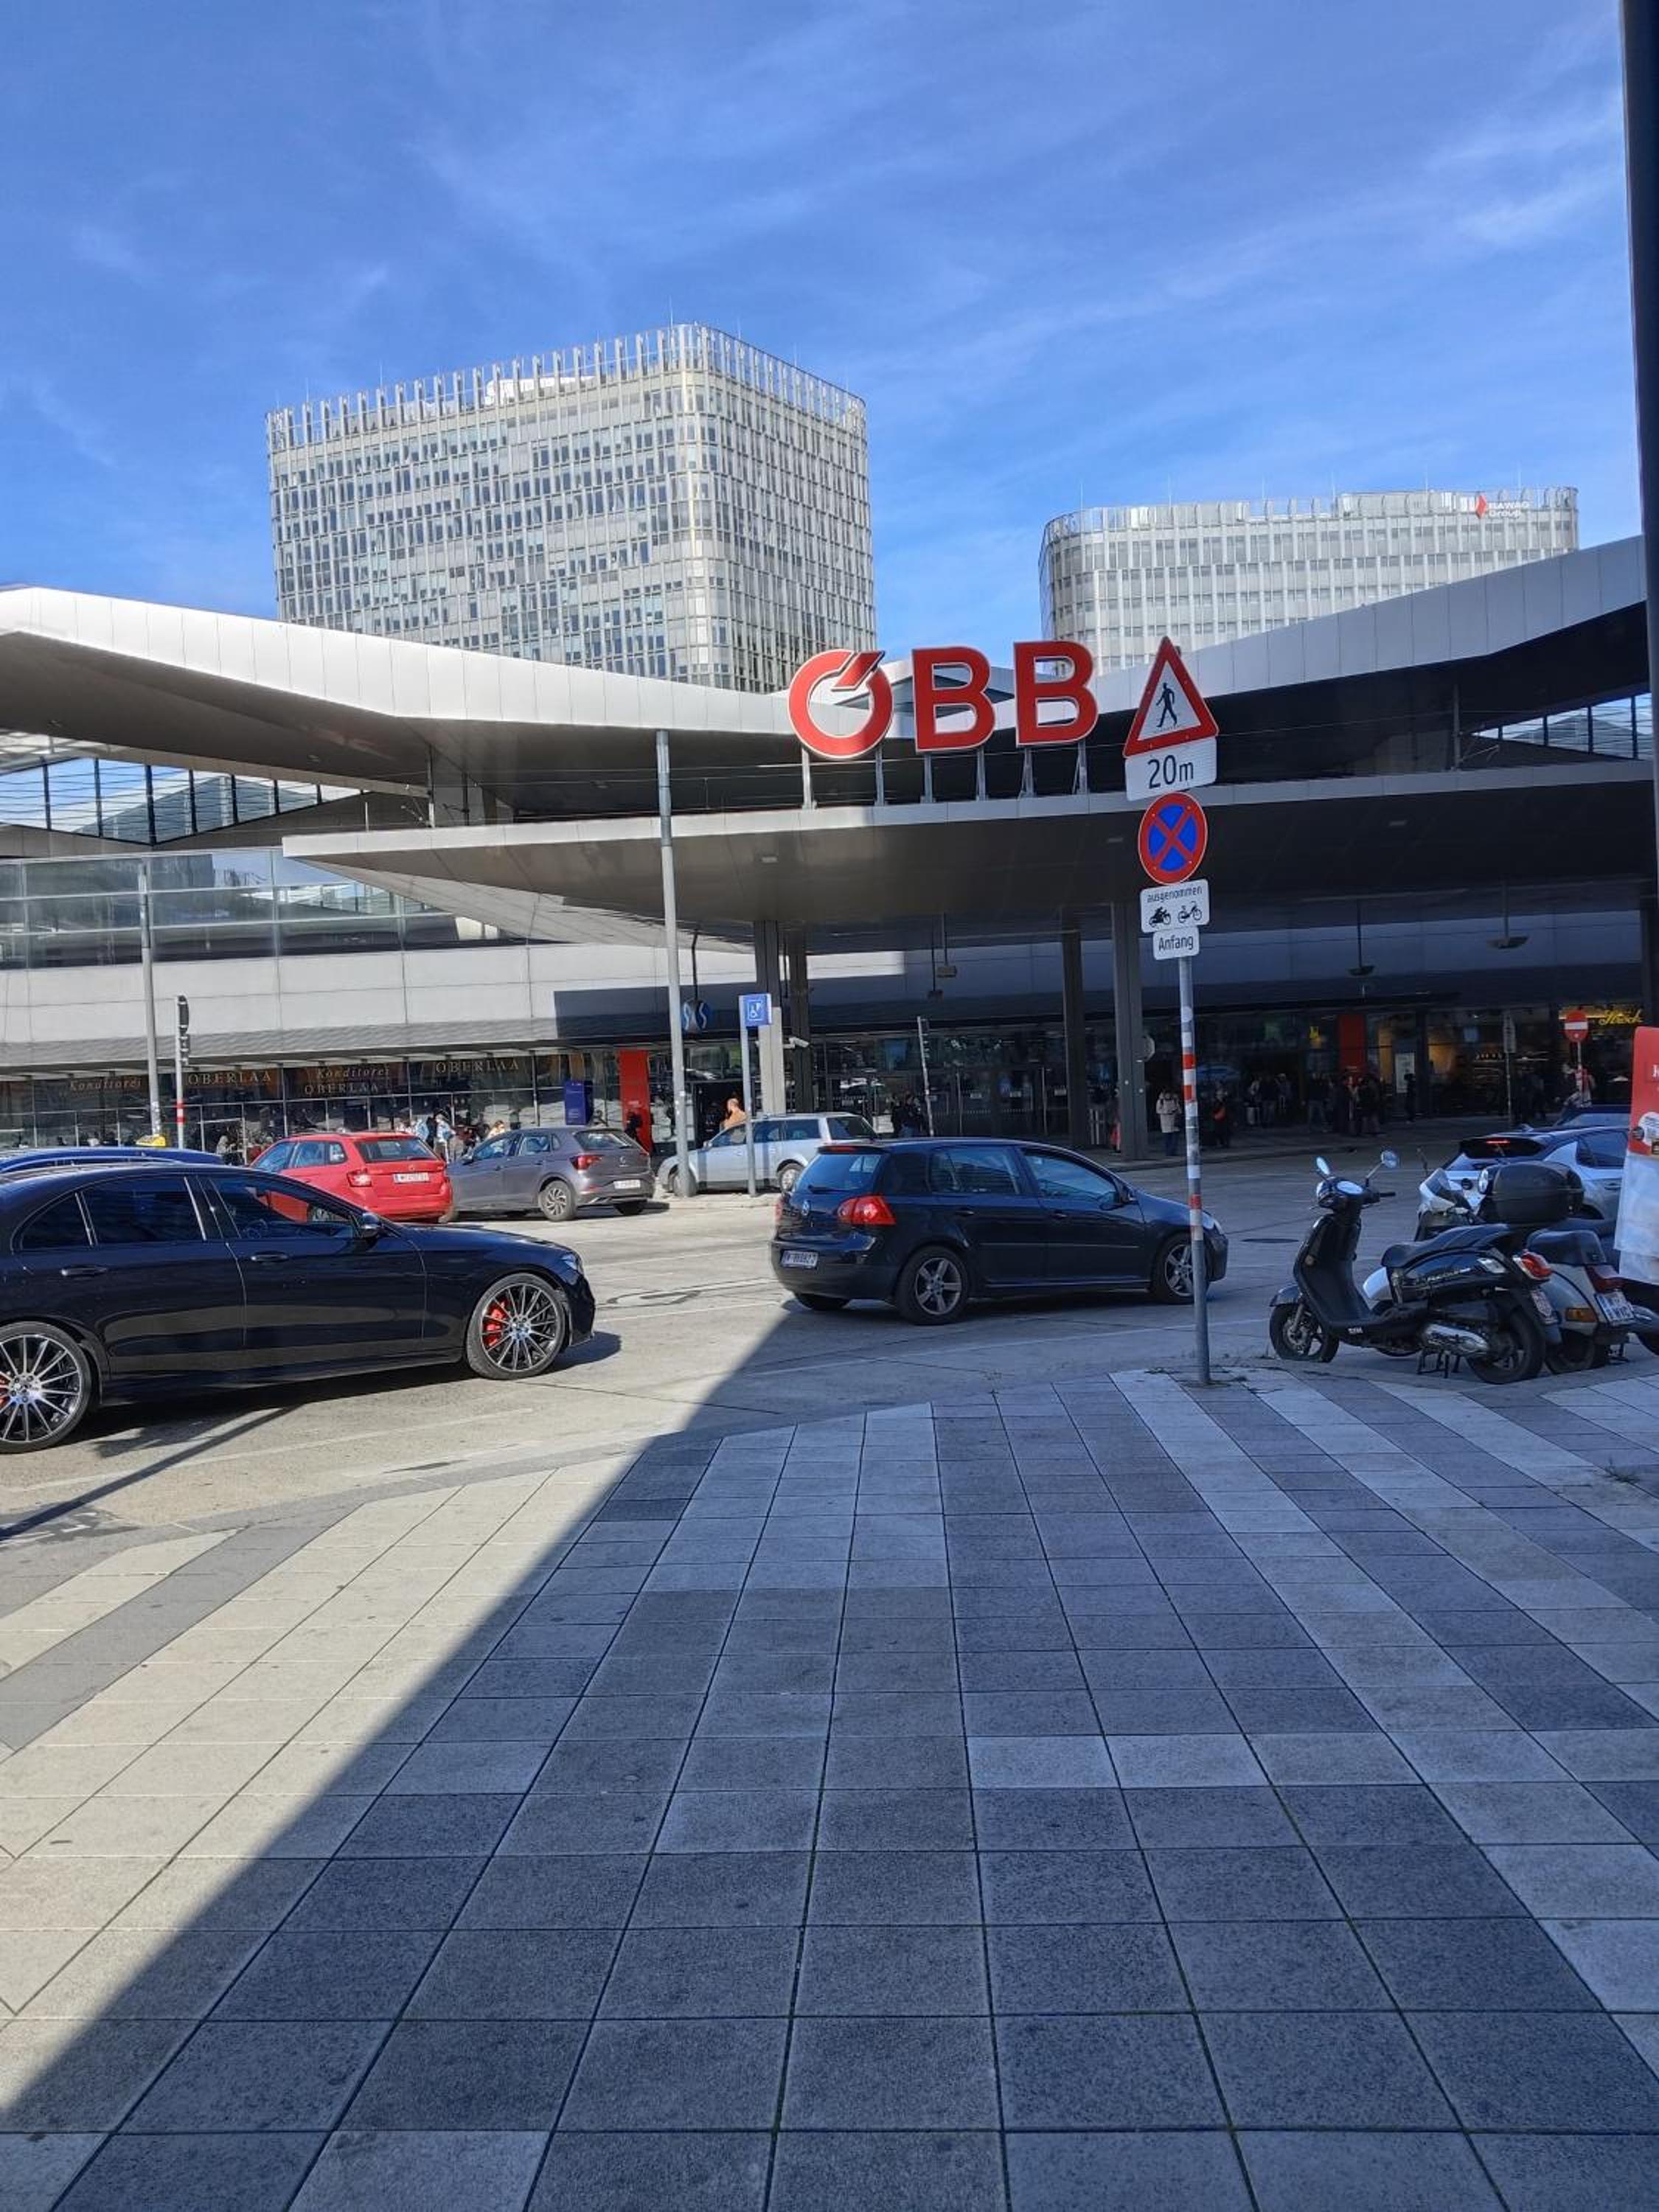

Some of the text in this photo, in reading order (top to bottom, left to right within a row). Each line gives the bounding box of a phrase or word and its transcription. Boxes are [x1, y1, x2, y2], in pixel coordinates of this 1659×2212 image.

[1147, 754, 1194, 789] 20m
[1147, 886, 1203, 903] ausgenommen
[1158, 934, 1194, 951] Anfang
[435, 1061, 520, 1074] OBERLAA
[187, 1071, 271, 1086] OBERLAA
[305, 1082, 379, 1095] OBERLAA
